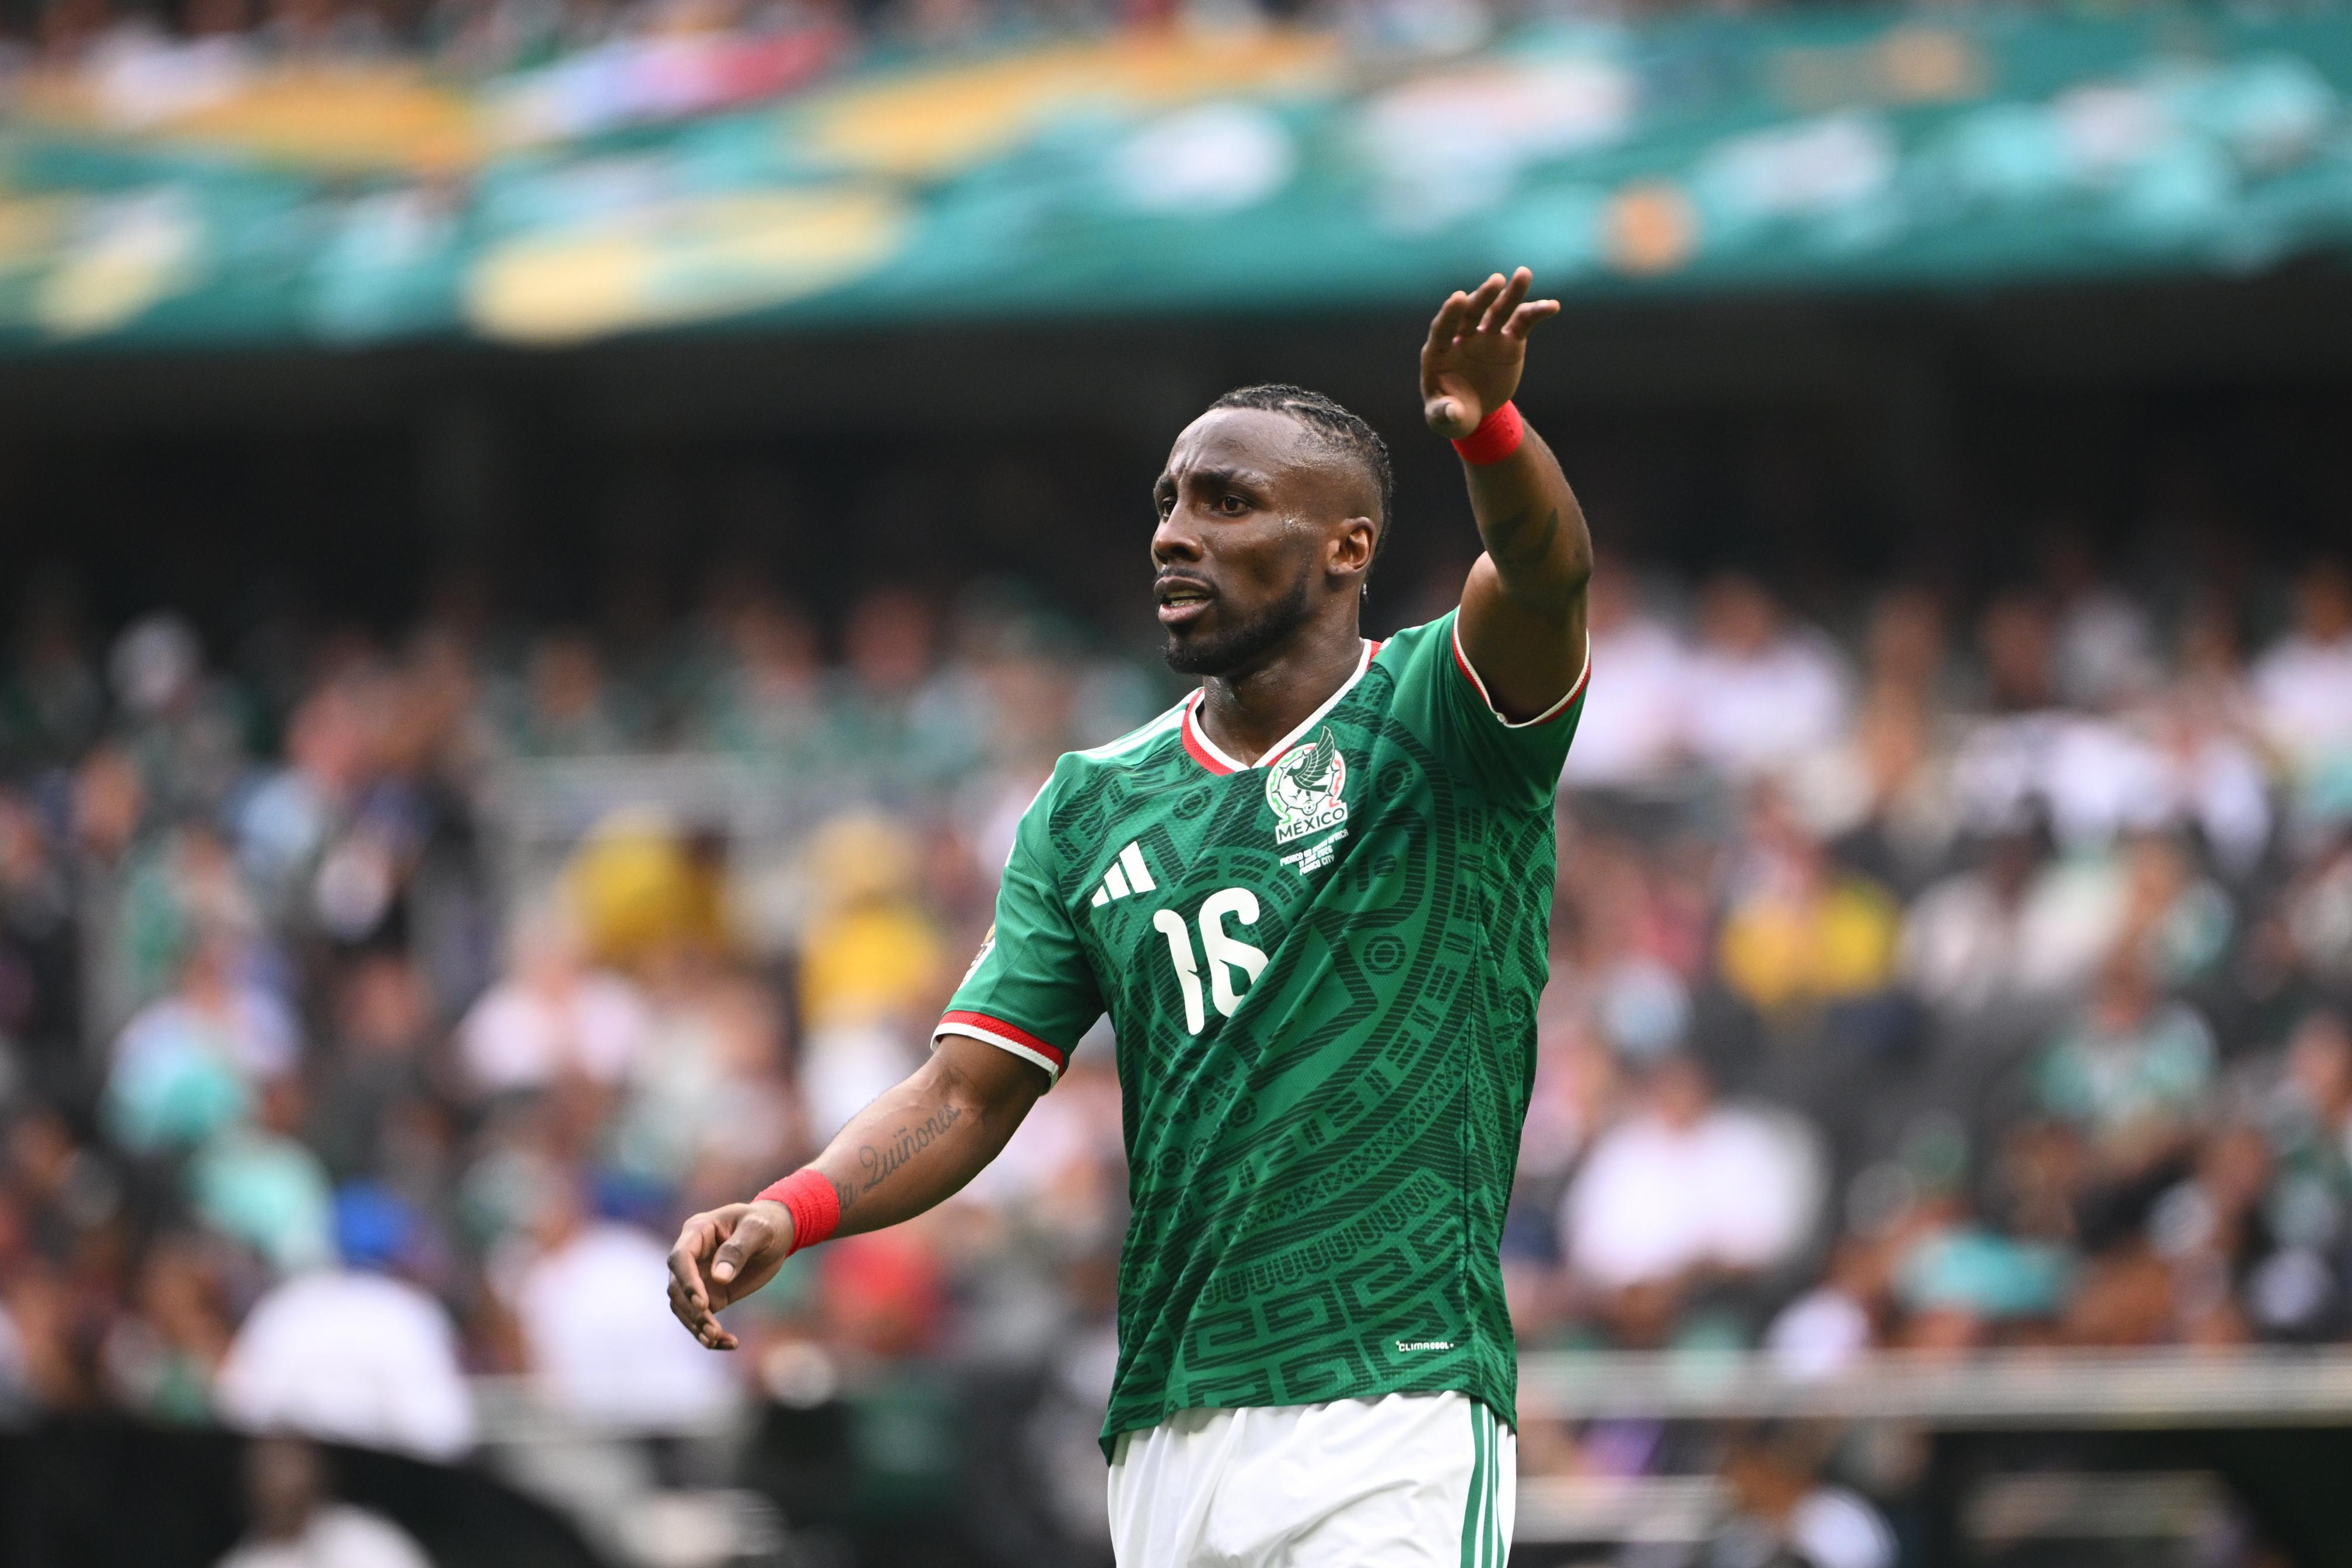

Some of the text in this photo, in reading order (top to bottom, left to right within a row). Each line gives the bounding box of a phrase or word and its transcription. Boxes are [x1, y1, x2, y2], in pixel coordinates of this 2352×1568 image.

[1279, 808, 1345, 841] MÉXICO
[1317, 845, 1333, 858] 2026
[1321, 854, 1334, 866] CITY
[1153, 887, 1269, 1035] 16
[1399, 1342, 1449, 1352] CLIMACOOL
